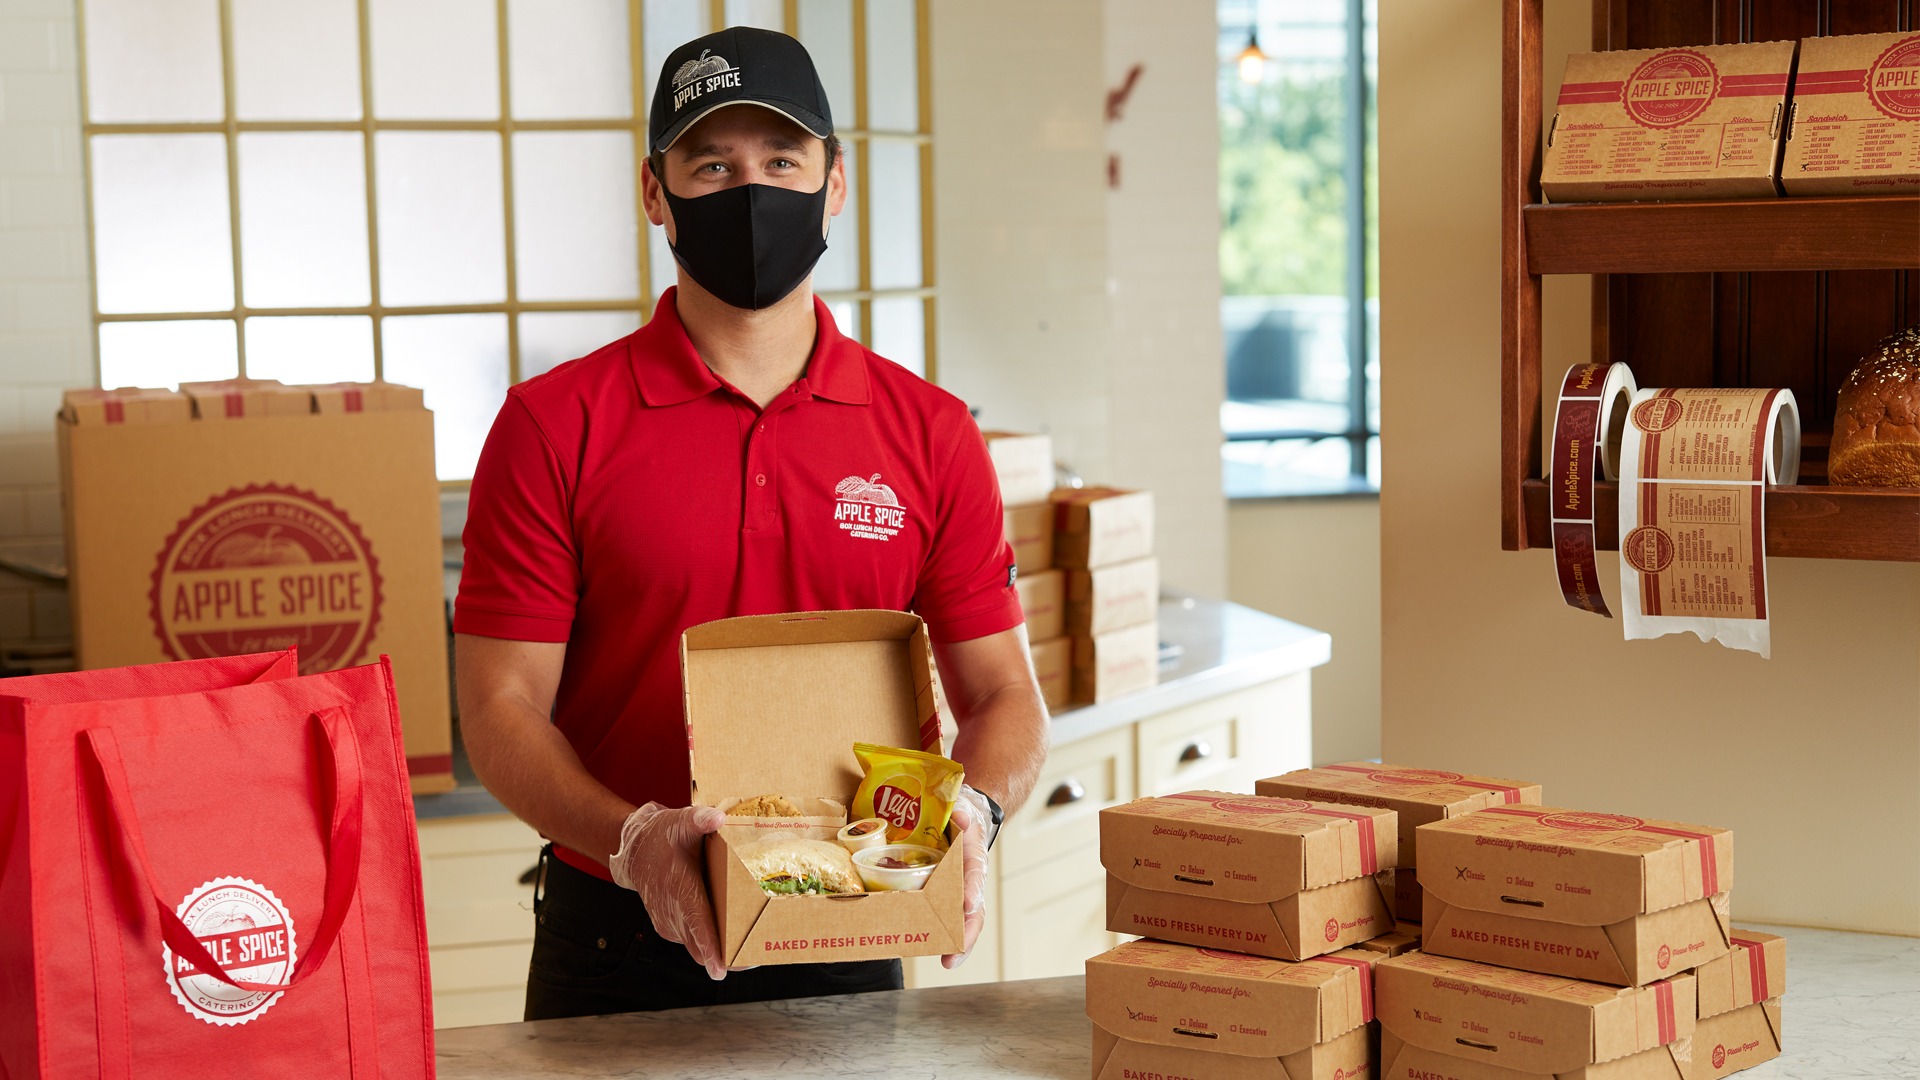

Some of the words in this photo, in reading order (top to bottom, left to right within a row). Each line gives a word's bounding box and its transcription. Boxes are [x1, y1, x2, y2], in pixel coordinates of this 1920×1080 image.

[1898, 43, 1920, 54] LUNC
[1654, 57, 1680, 67] LUNCH
[1681, 56, 1708, 74] DELIVERY
[1876, 70, 1918, 88] APPLE
[674, 82, 702, 112] APPLE
[706, 72, 742, 92] SPICE
[1631, 82, 1670, 98] APPLE
[1674, 80, 1711, 96] SPICE
[1888, 102, 1920, 113] CATERIN
[1640, 112, 1676, 123] CATERING
[1807, 114, 1849, 123] Sandwich
[1604, 182, 1643, 190] Specially
[1645, 181, 1687, 190] Prepared
[1655, 399, 1667, 412] SPICE
[1651, 412, 1662, 429] APPLE
[1565, 440, 1580, 510] AppleSpice.com
[834, 503, 872, 523] APPLE
[874, 507, 906, 528] SPICE
[181, 534, 206, 565] BOX
[208, 504, 269, 532] LUNCH
[274, 504, 351, 555] DELIVERY
[850, 530, 878, 540] CATERING
[853, 523, 873, 532] LUNCH
[874, 526, 899, 536] DELIVERY
[1646, 530, 1654, 548] SPICE
[1647, 549, 1655, 569] APPLE
[174, 577, 267, 623] APPLE
[280, 572, 363, 616] SPICE
[1306, 789, 1338, 803] Specially
[1339, 793, 1374, 806] Prepared
[878, 786, 918, 827] Lay's
[1153, 825, 1188, 840] Specially
[1189, 830, 1227, 844] Prepared
[1227, 835, 1243, 846] for:
[1475, 835, 1514, 850] Specially
[1516, 840, 1557, 854] Prepared
[1558, 846, 1576, 857] for:
[1144, 859, 1161, 869] Classic
[1188, 864, 1205, 875] Deluxe
[1232, 871, 1257, 882] Executive
[1466, 870, 1485, 880] Classic
[1516, 876, 1534, 887] Deluxe
[1565, 883, 1591, 895] Executive
[186, 913, 196, 928] OX
[196, 891, 230, 912] LUNCH
[233, 891, 276, 918] DELIVERY
[1133, 914, 1167, 928] BAKED
[1171, 921, 1204, 933] FRESH
[1208, 926, 1242, 939] EVERY
[1246, 931, 1268, 944] DAY
[1340, 921, 1356, 930] Please
[1357, 914, 1375, 927] Recycle
[764, 940, 808, 951] BAKED
[813, 937, 855, 948] FRESH
[860, 934, 901, 946] EVERY
[905, 932, 930, 943] DAY
[1451, 928, 1489, 942] BAKED
[1493, 935, 1530, 949] FRESH
[1534, 941, 1571, 956] EVERY
[1576, 948, 1599, 960] DAY
[1672, 946, 1688, 956] Please
[1688, 941, 1705, 952] Recycle
[178, 938, 232, 972] ALE
[239, 930, 286, 963] SPICE
[1147, 976, 1188, 992] Specially
[1189, 981, 1233, 995] Prepared
[1233, 986, 1251, 999] for:
[1433, 977, 1470, 995] Specially
[1471, 984, 1511, 1002] Prepared
[1511, 993, 1529, 1005] for:
[198, 996, 254, 1011] CATERING
[1138, 1012, 1158, 1023] Classic
[1189, 1018, 1208, 1029] Deluxe
[1423, 1011, 1442, 1024] Classic
[1239, 1024, 1267, 1036] Executive
[1470, 1021, 1488, 1034] Deluxe
[1517, 1032, 1544, 1046] Executive
[1727, 1046, 1742, 1056] Please
[1742, 1040, 1760, 1052] Recycle
